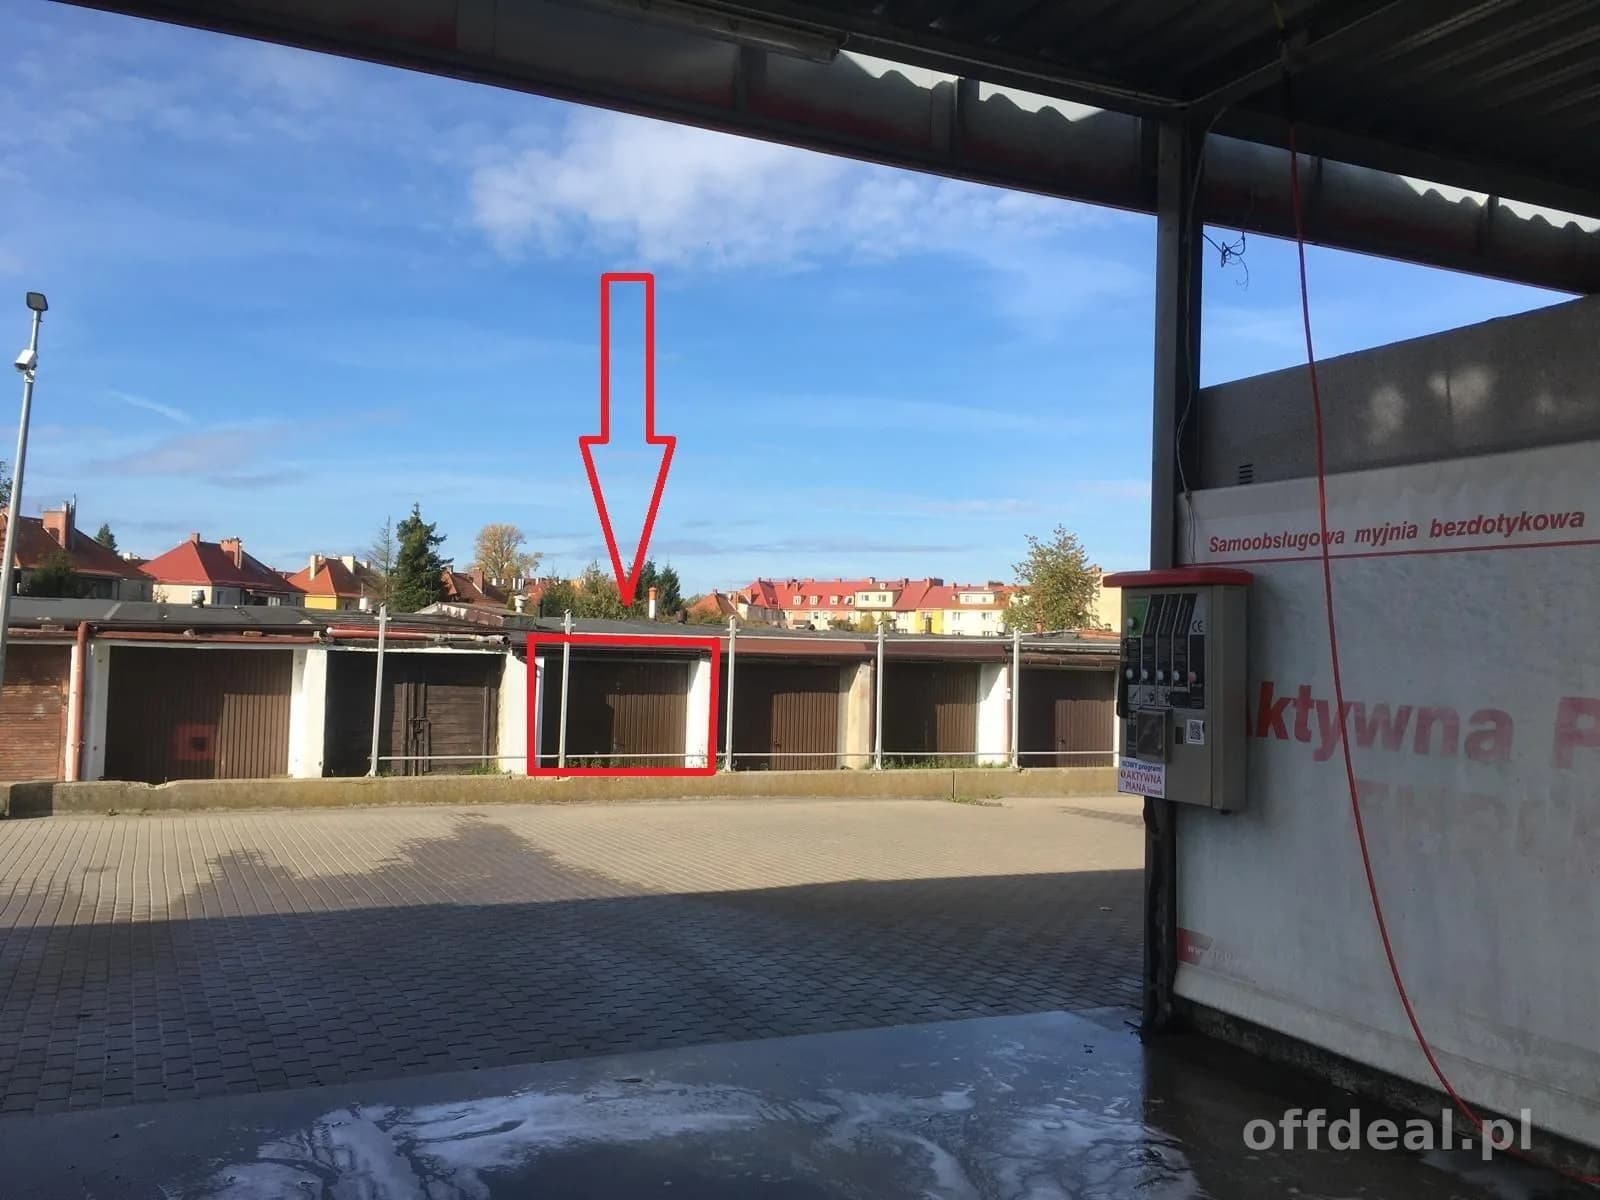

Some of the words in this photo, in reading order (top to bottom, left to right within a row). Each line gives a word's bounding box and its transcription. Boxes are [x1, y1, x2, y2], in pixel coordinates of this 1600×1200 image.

[1354, 521, 1419, 547] myjnia
[1429, 511, 1585, 538] bezdotykowa
[1246, 681, 1515, 762] ktywna
